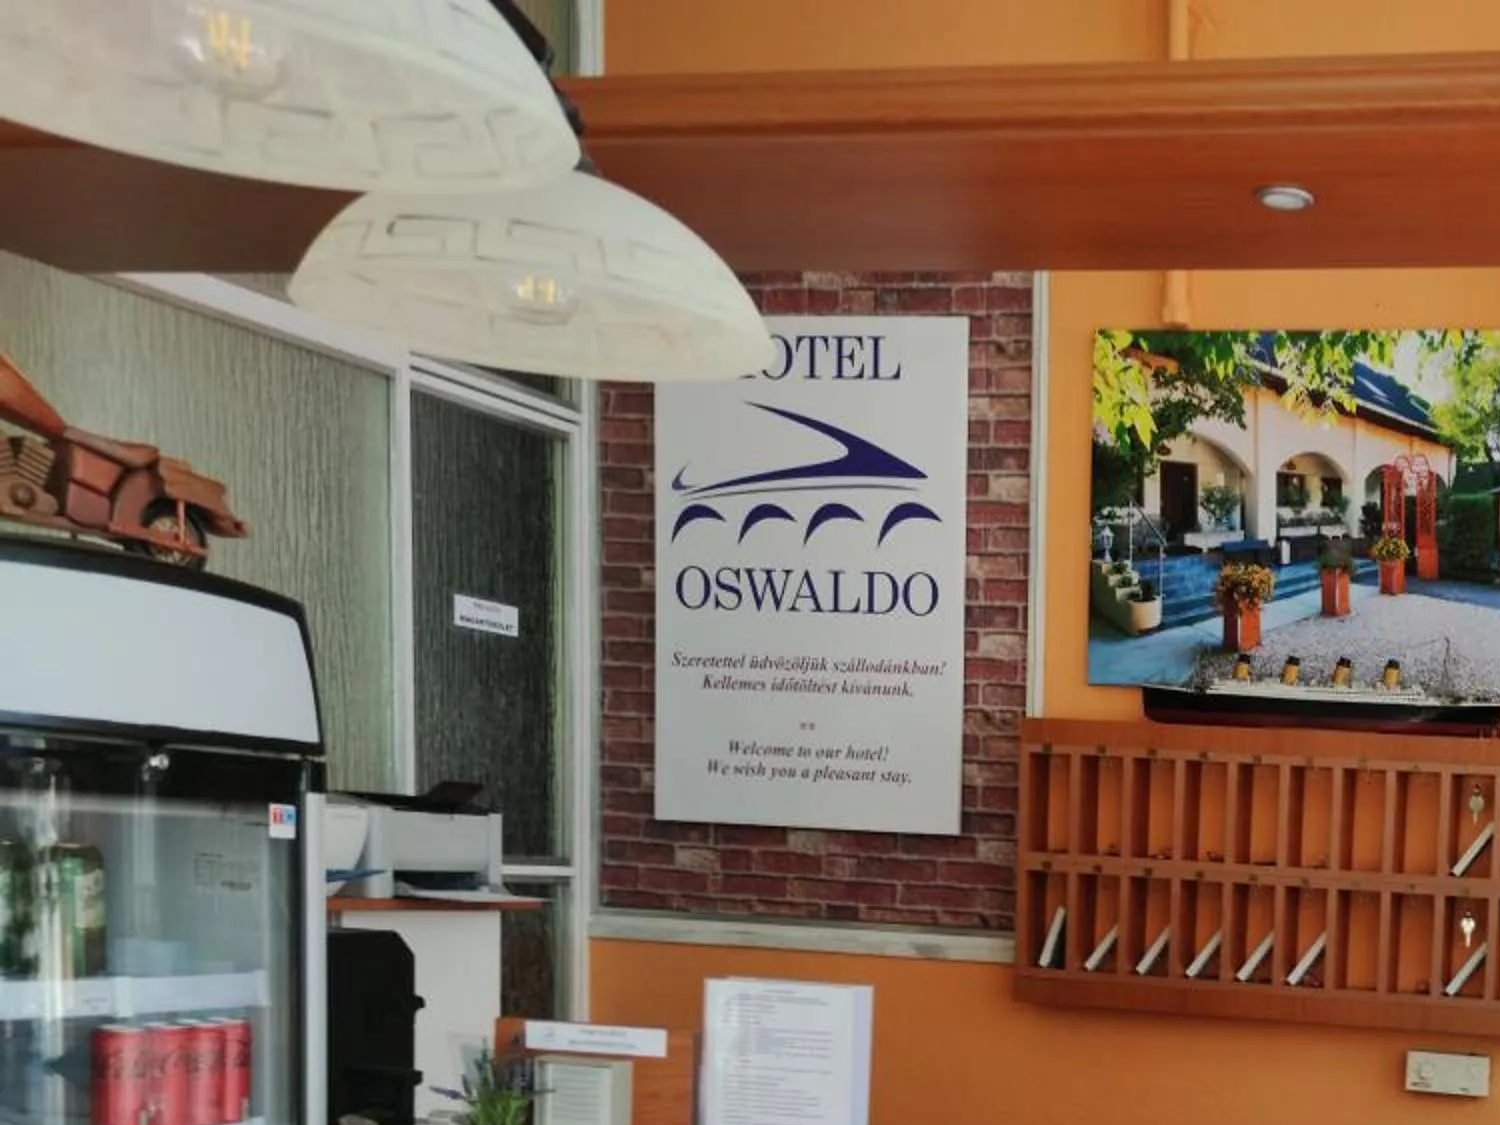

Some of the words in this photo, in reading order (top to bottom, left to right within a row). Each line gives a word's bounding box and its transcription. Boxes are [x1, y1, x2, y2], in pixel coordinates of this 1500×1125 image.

[738, 334, 901, 381] OTEL
[675, 565, 939, 617] OSWALDO
[671, 651, 746, 670] Szeretettel
[749, 655, 828, 676] üdvözöljük
[702, 674, 766, 692] Kellemes
[728, 740, 794, 758] Welcome
[797, 744, 811, 758] to
[815, 747, 842, 760] our
[845, 745, 889, 762] hotel!
[707, 759, 730, 776] We
[733, 761, 766, 778] wish
[769, 765, 796, 781] you
[801, 767, 810, 779] a
[813, 765, 876, 783] pleasant
[880, 768, 912, 787] stay.
